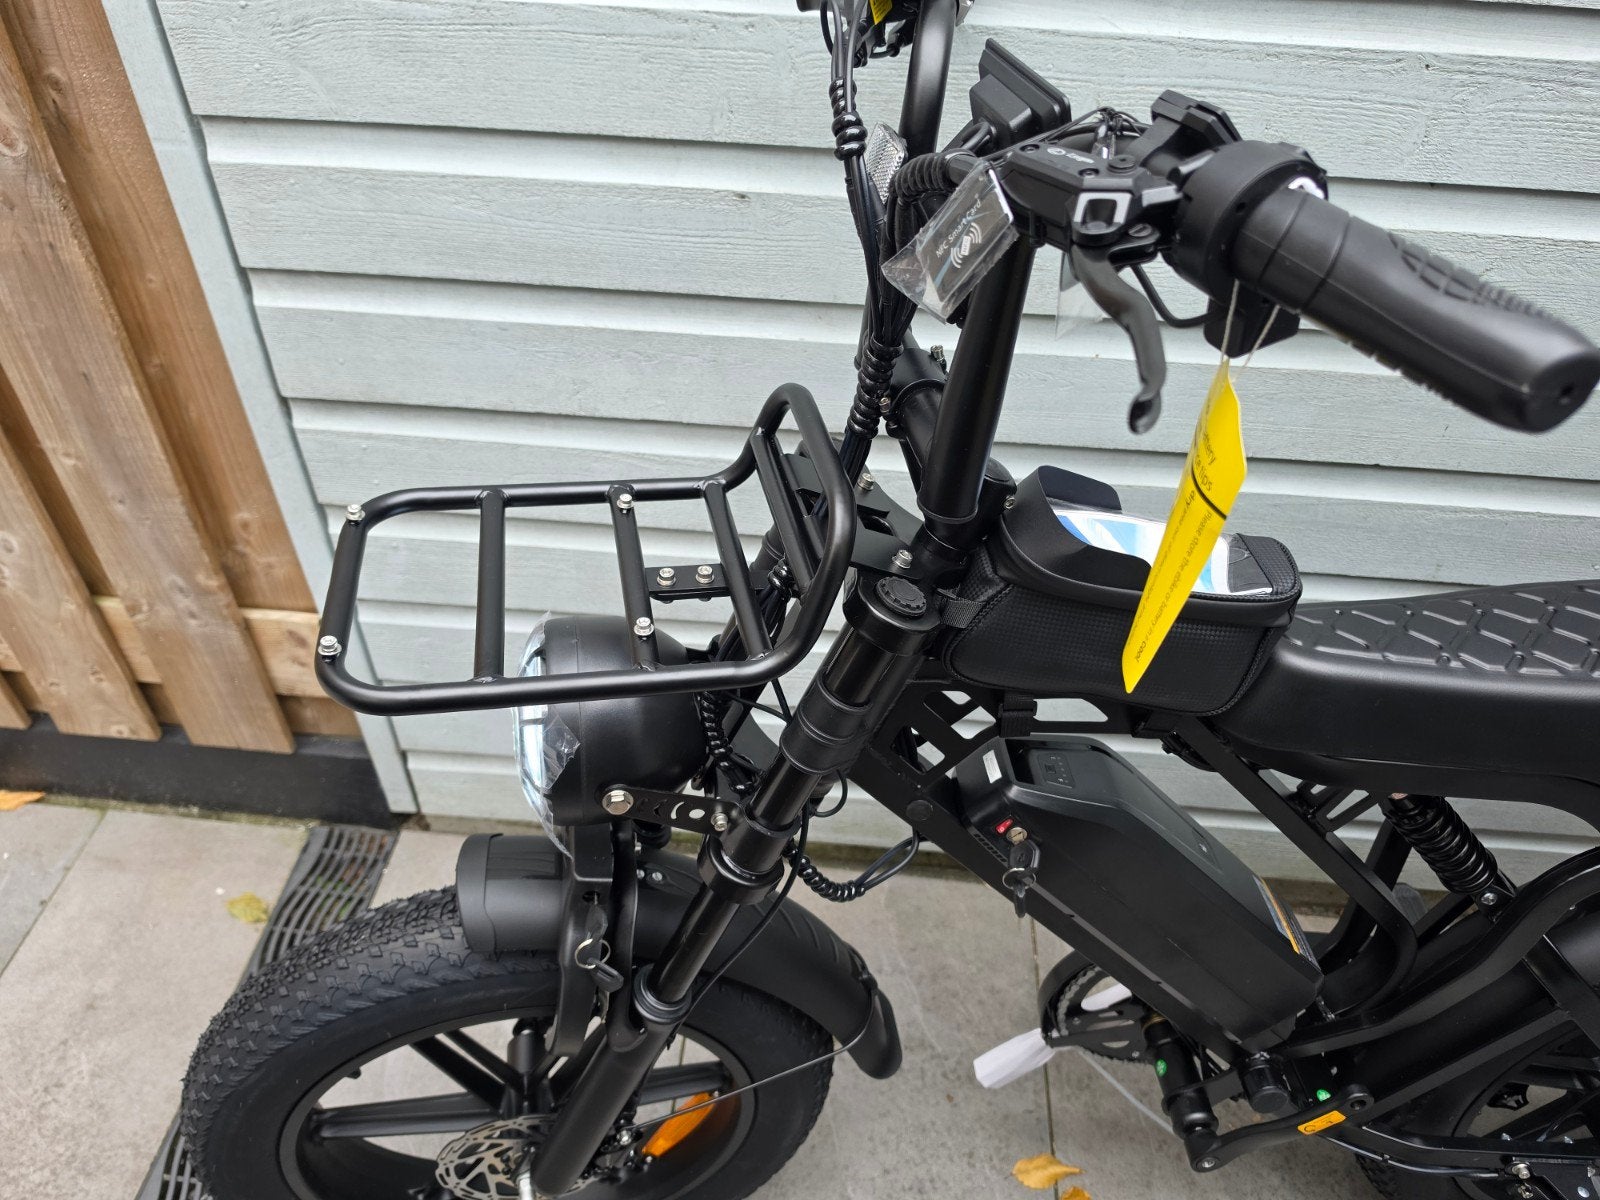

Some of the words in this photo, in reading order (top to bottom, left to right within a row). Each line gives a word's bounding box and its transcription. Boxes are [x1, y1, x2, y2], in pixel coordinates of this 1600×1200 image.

[936, 241, 949, 258] NFC
[1184, 490, 1196, 509] dry
[1195, 510, 1213, 537] Please
[1186, 536, 1199, 557] store
[1178, 557, 1189, 572] the
[1134, 640, 1147, 663] cool
